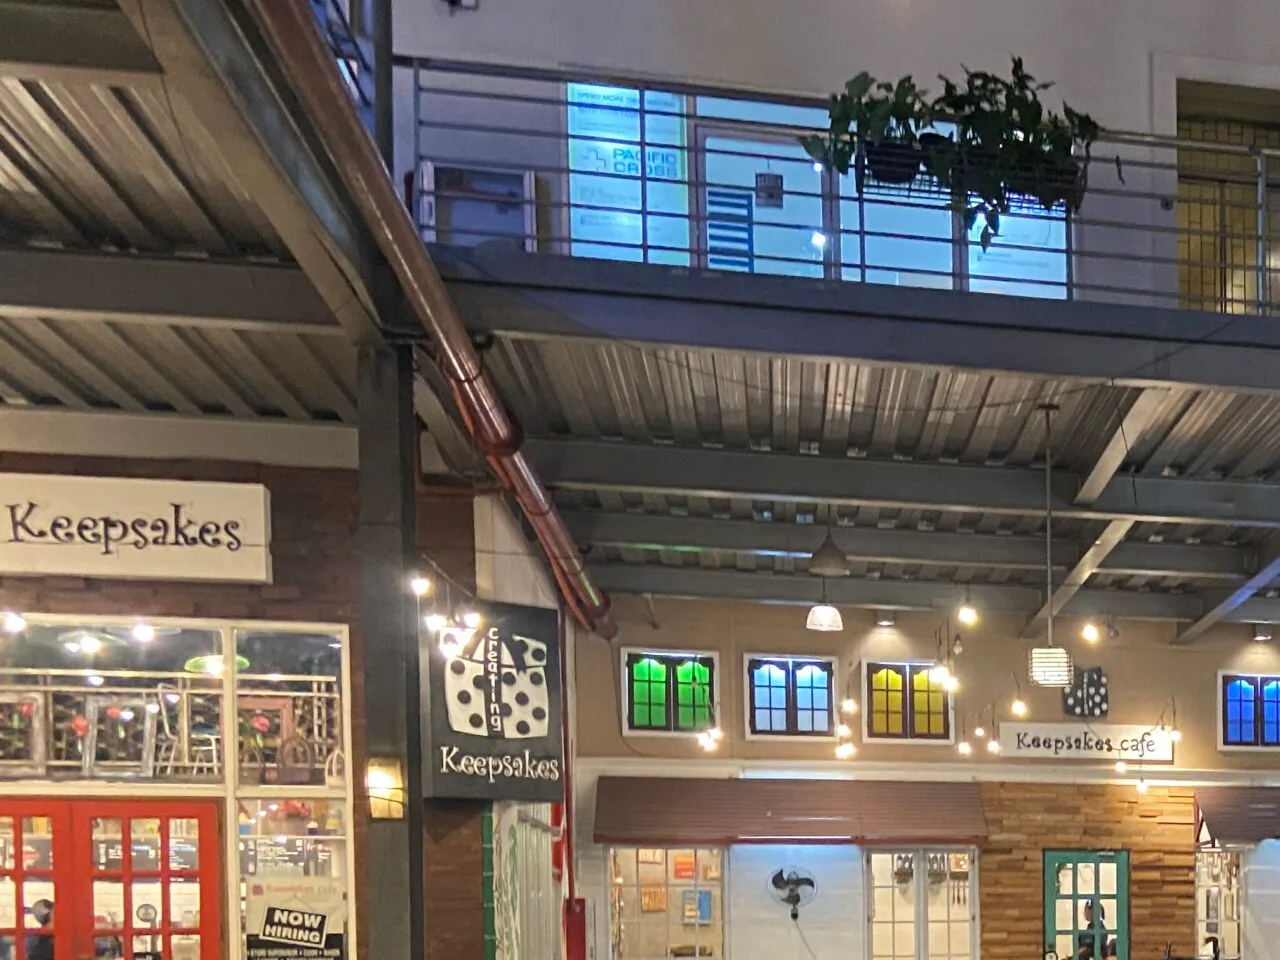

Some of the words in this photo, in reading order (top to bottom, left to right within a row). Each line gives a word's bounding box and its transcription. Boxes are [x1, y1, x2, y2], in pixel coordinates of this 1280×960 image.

[5, 500, 242, 555] Keepsakes
[487, 627, 502, 732] creating
[1016, 731, 1114, 755] Keepsakes
[1120, 732, 1156, 757] cafe
[440, 746, 560, 784] Keepsakes
[264, 924, 321, 943] HIRING
[273, 909, 322, 928] NOW
